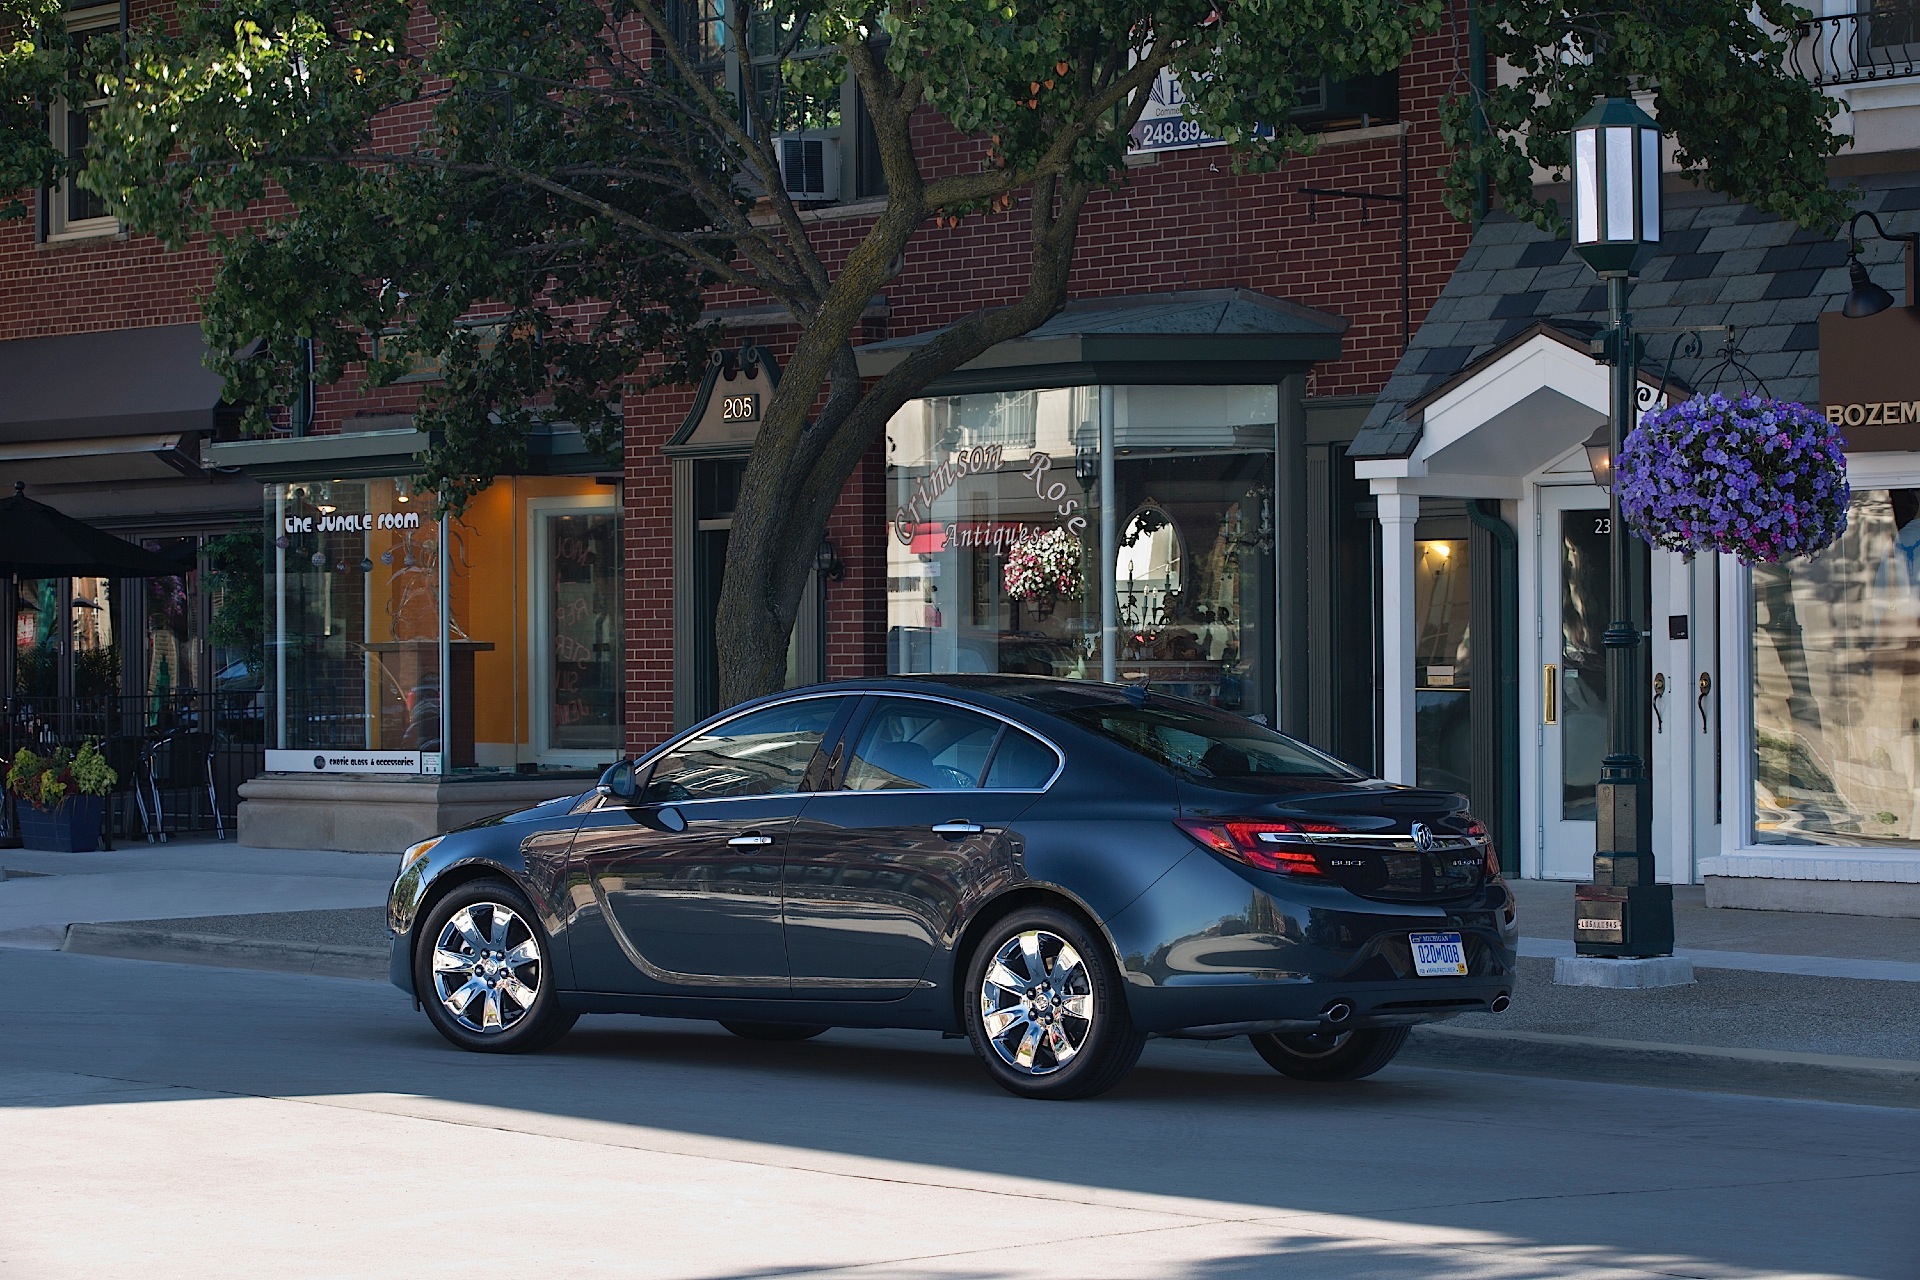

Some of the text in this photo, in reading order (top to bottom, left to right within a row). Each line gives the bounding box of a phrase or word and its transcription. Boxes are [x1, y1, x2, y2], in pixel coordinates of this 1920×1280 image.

[723, 397, 752, 419] 205
[1825, 401, 1920, 427] BOZEM
[893, 444, 1088, 546] Crimson Rose
[285, 515, 312, 533] the
[377, 512, 419, 530] room
[941, 520, 1042, 557] Antiques
[329, 755, 349, 766] exotic
[376, 756, 414, 767] accessories
